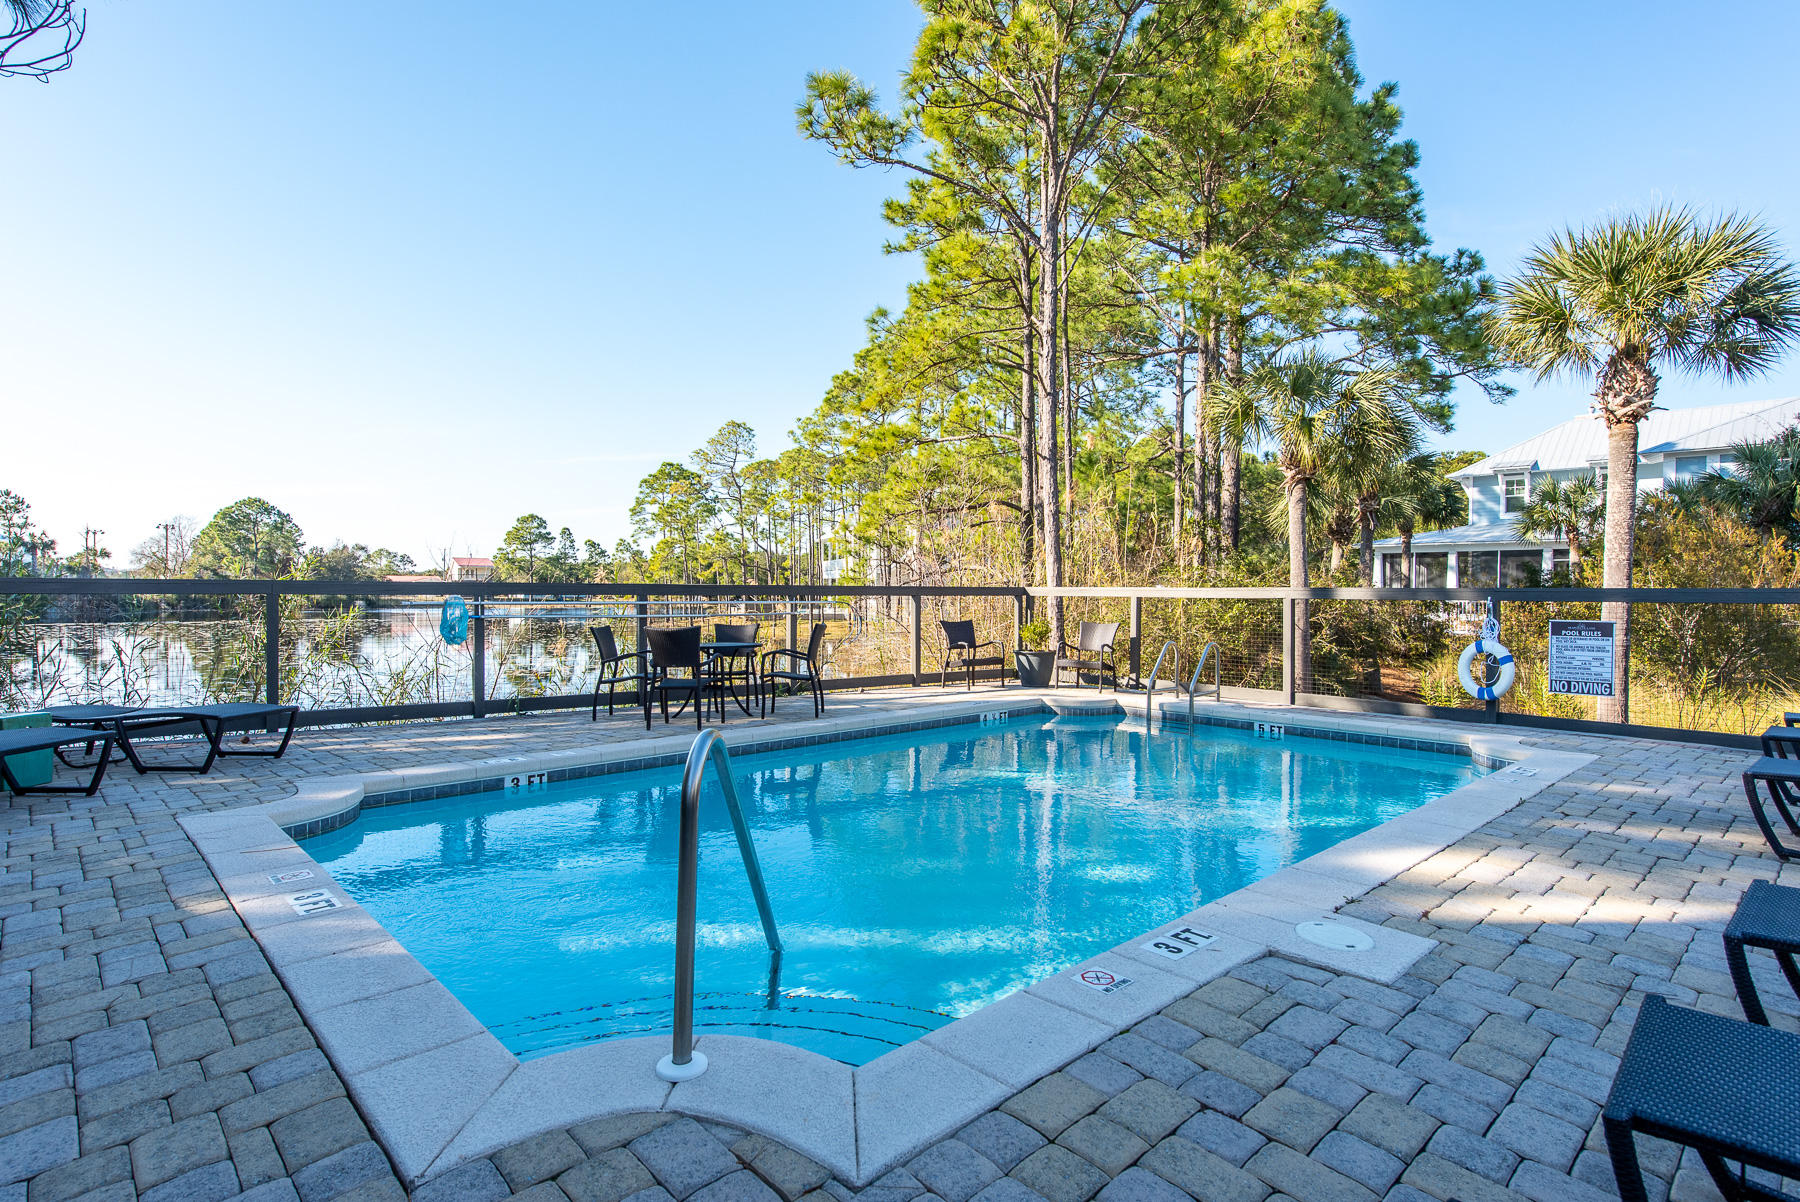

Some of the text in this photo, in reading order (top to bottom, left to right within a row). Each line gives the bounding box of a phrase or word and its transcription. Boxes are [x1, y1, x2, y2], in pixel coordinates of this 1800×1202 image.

[1551, 680, 1611, 695] NO DIVING
[511, 773, 546, 788] 3 FT
[293, 892, 337, 914] 3 FT
[1153, 927, 1214, 954] 3 FT
